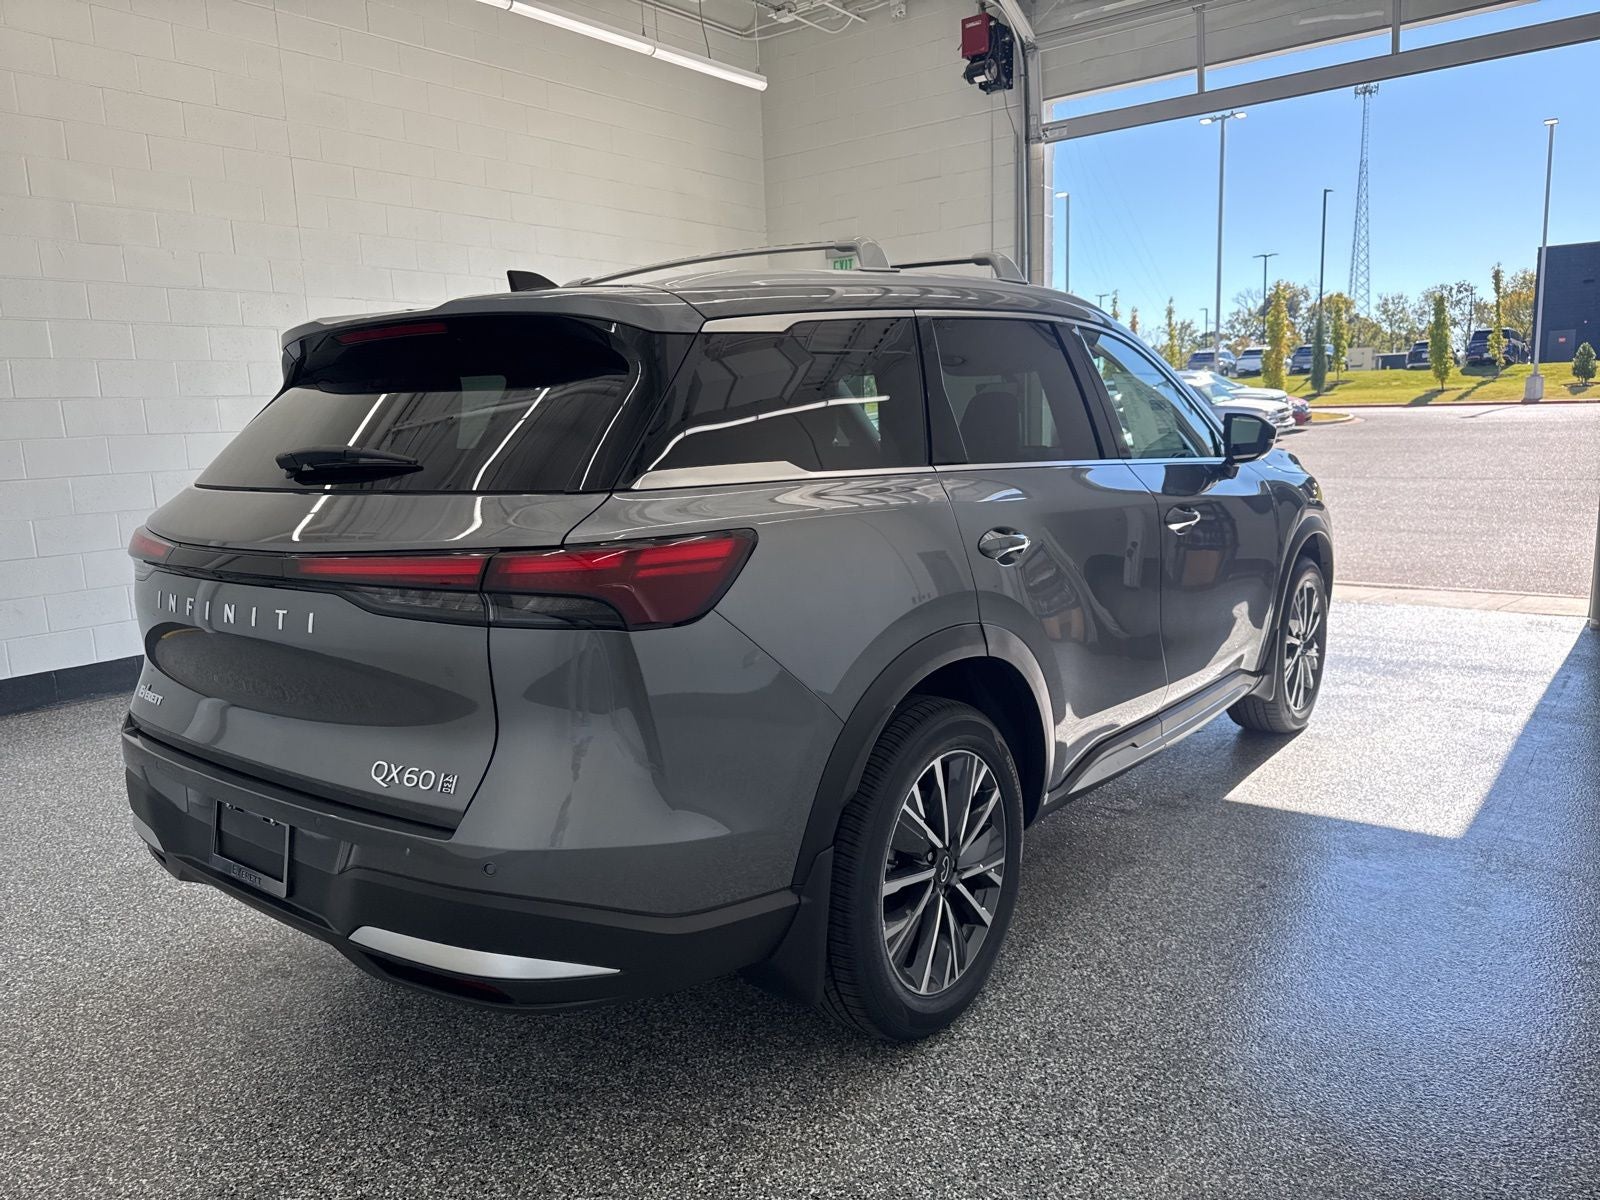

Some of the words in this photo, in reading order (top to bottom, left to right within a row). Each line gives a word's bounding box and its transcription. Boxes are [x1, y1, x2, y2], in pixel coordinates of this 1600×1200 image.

[833, 258, 853, 270] EXIT
[157, 589, 314, 634] INFINITI
[371, 760, 436, 790] QX60
